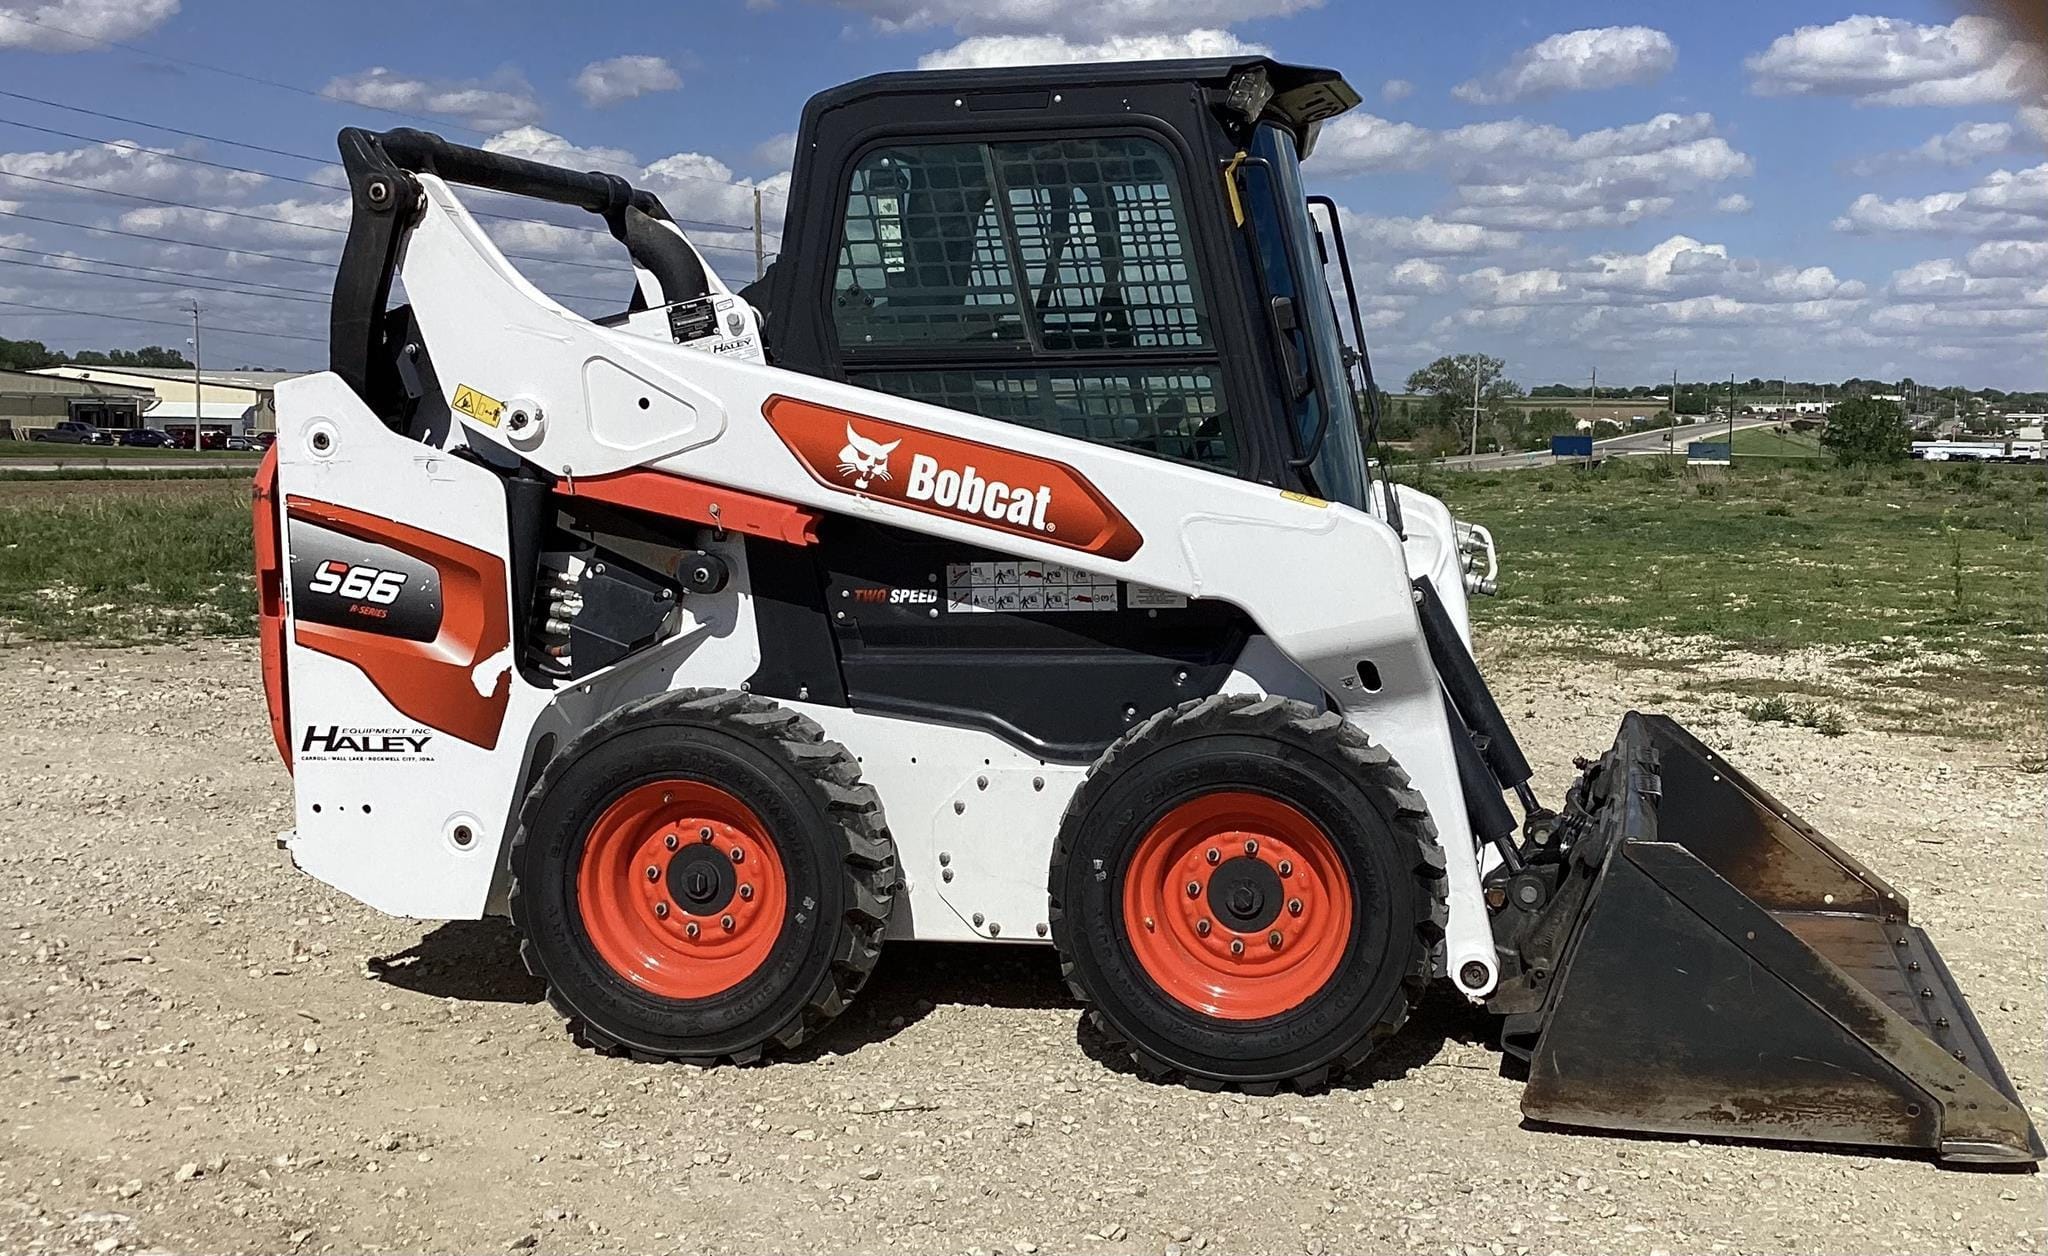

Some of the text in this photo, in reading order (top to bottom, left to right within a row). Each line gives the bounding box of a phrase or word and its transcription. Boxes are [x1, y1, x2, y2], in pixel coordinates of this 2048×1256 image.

[713, 337, 752, 353] HALEY
[905, 453, 1052, 531] Bobcat
[308, 560, 407, 605] S66
[855, 588, 939, 604] TWO SPEED
[350, 604, 388, 618] R-SERIES
[302, 726, 432, 752] HALEY
[342, 727, 407, 735] EQUIPMENT
